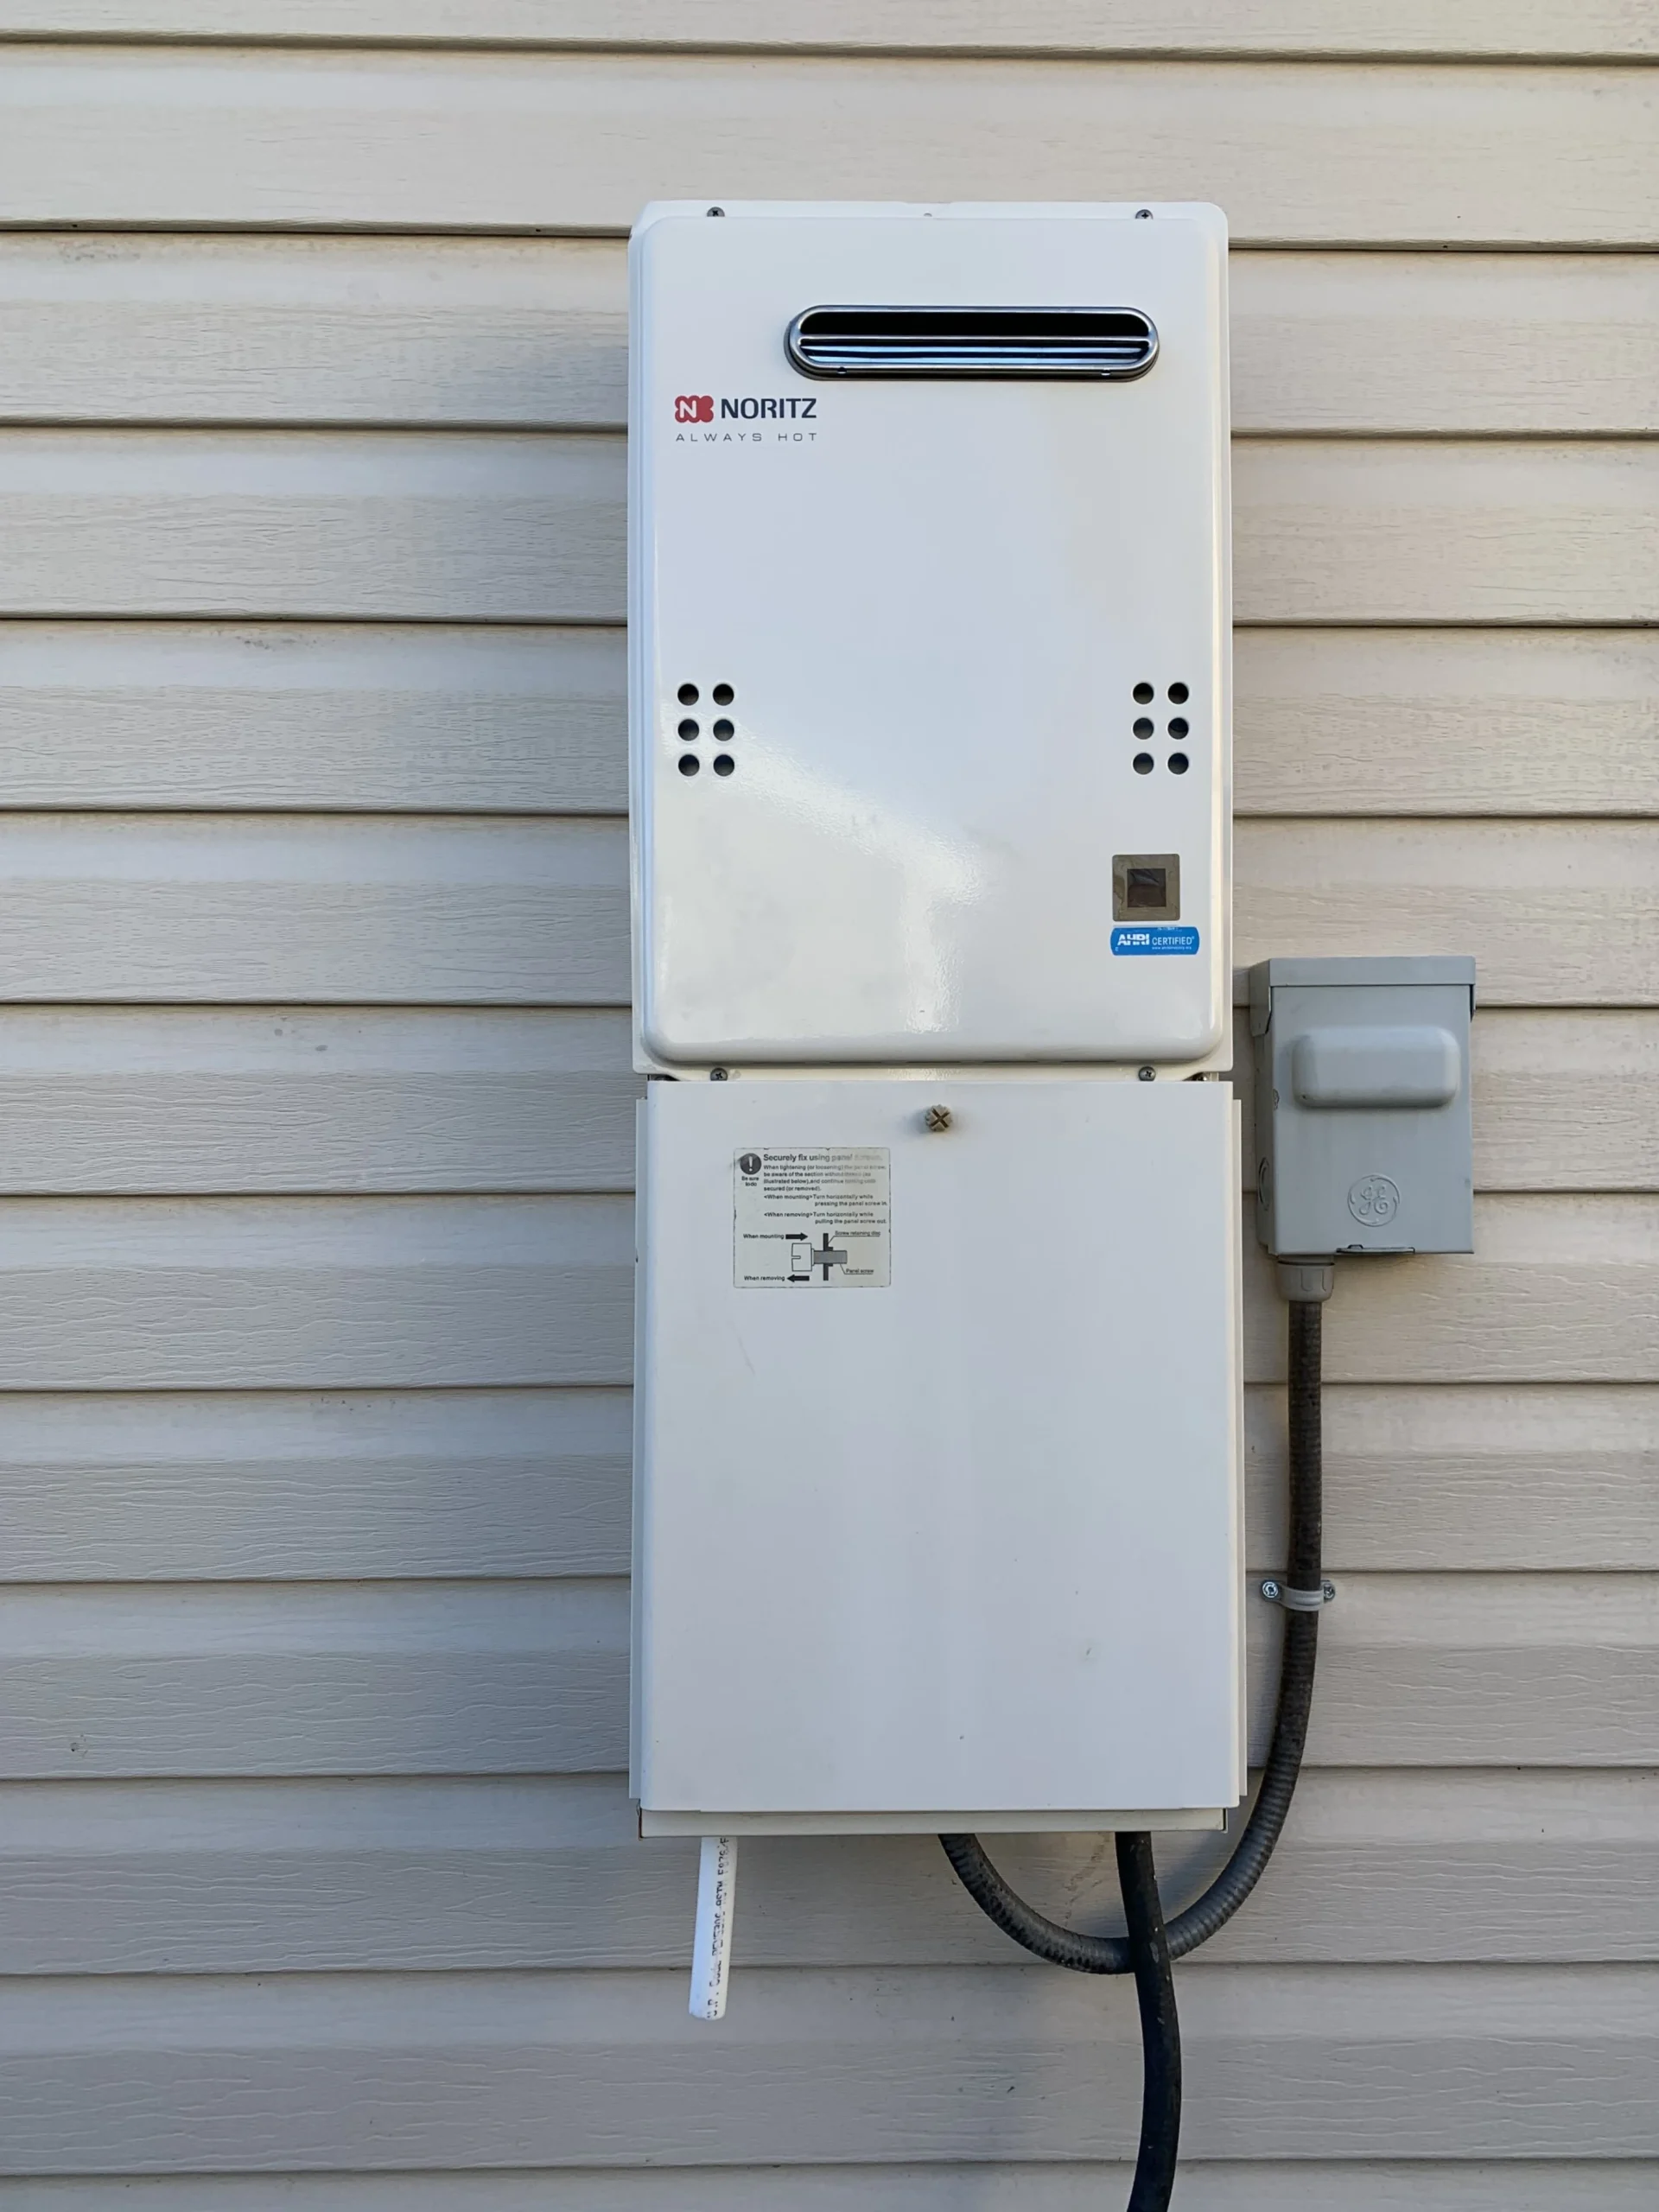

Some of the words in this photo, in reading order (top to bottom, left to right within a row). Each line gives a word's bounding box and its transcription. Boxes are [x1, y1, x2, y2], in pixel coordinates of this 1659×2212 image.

[721, 397, 817, 420] NORITZ
[676, 433, 762, 442] ALWAYS
[778, 433, 817, 442] HOT
[1117, 933, 1150, 946] AHRI
[764, 1154, 796, 1162] Securely
[809, 1154, 830, 1162] using
[831, 1154, 853, 1162] panel
